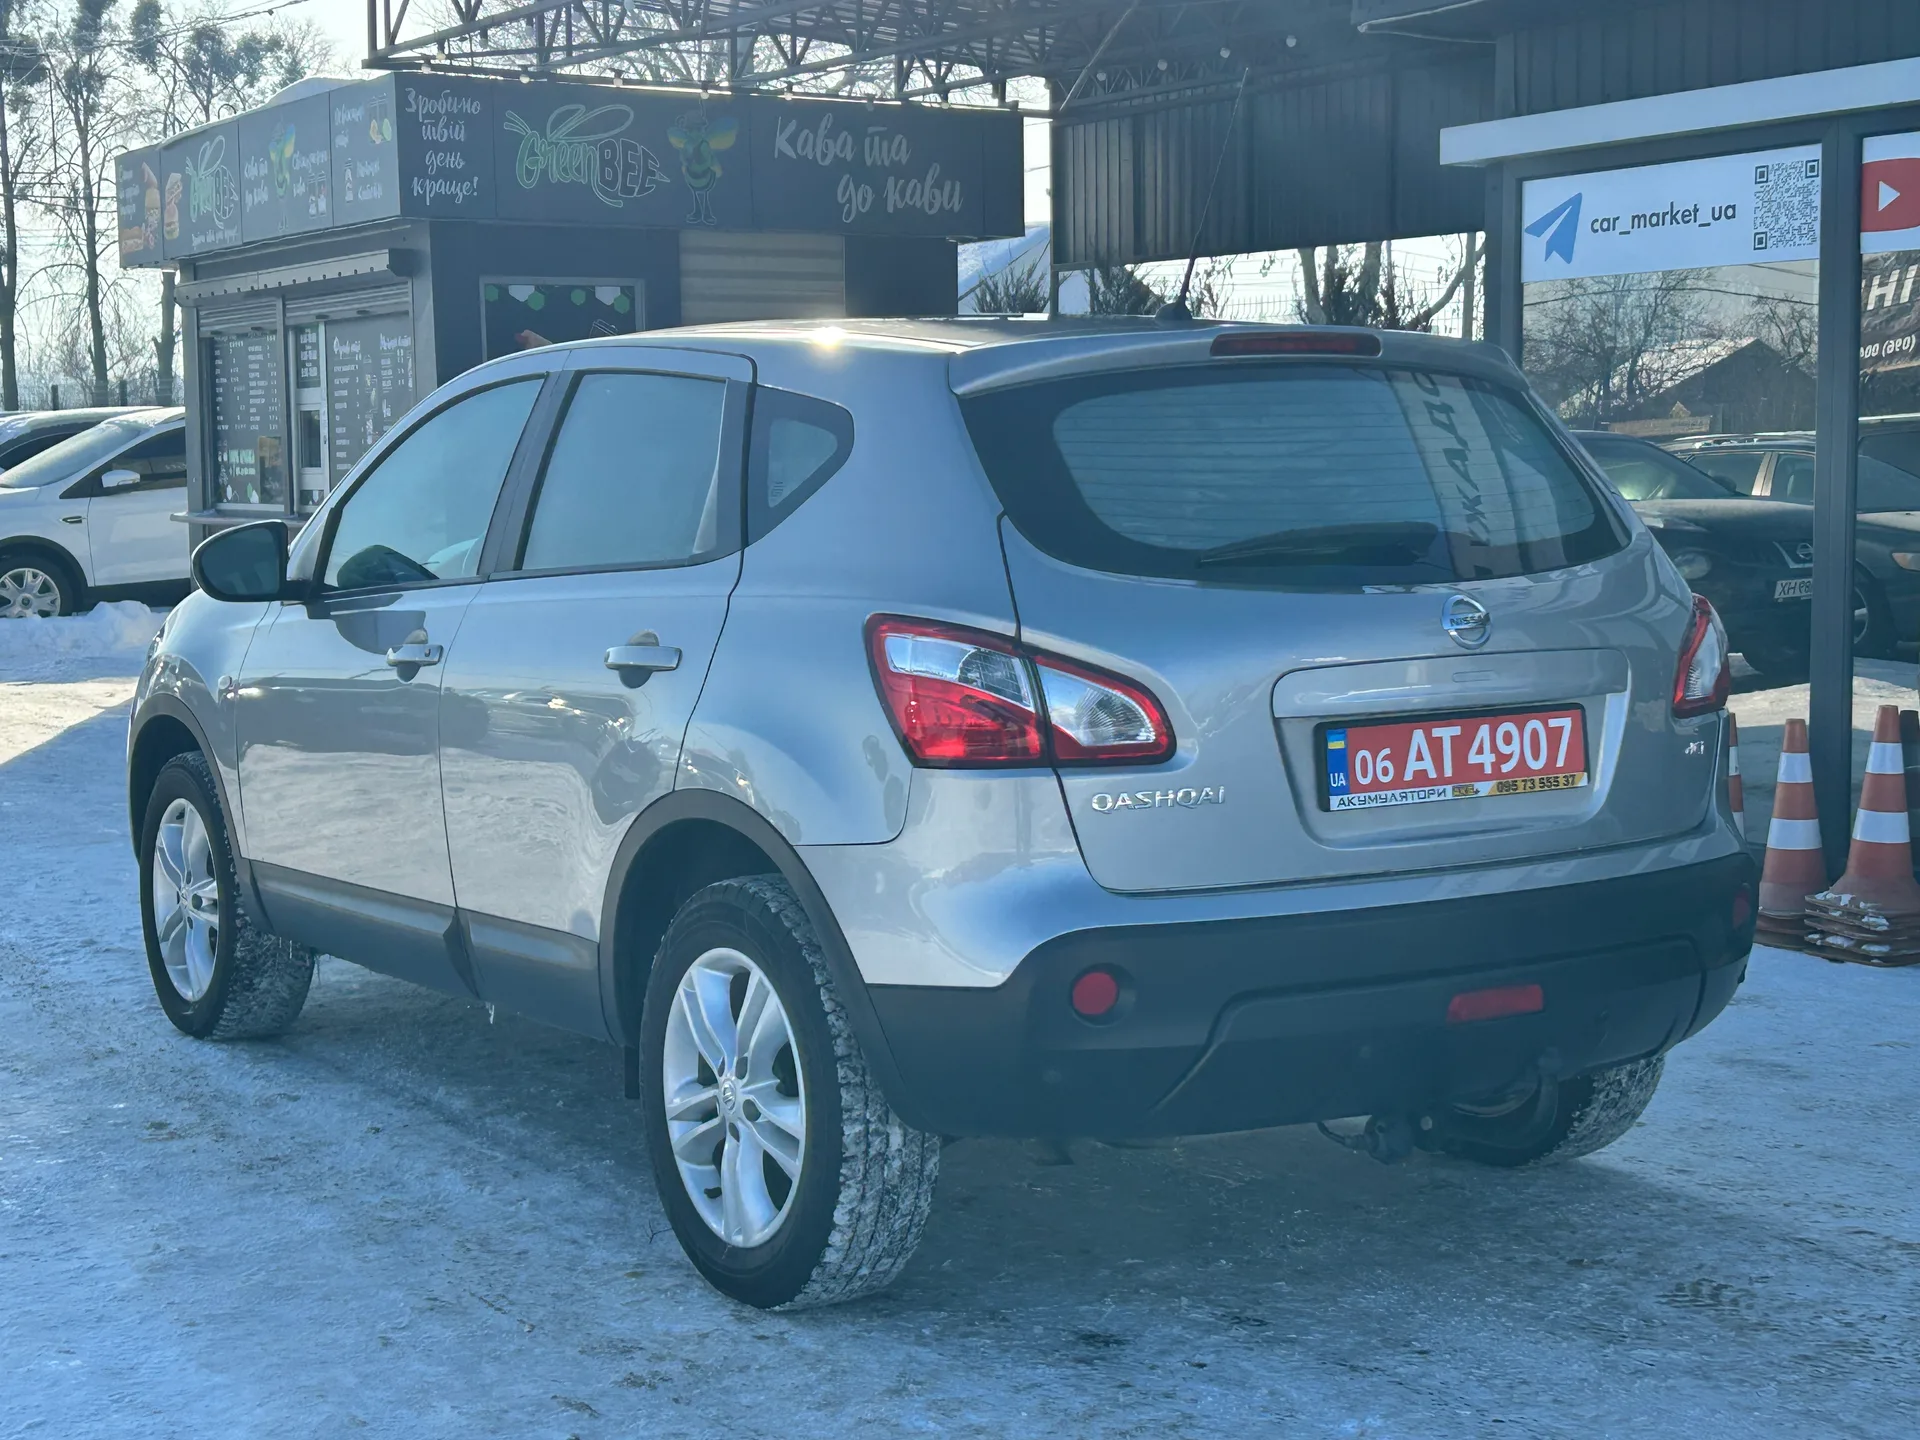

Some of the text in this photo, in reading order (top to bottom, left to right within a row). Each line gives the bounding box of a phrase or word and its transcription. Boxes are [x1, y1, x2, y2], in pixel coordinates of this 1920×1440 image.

[405, 88, 481, 121] Зробимо
[422, 114, 465, 143] твій
[774, 112, 912, 167] Кава та
[425, 149, 465, 175] день
[411, 176, 479, 205] краще!
[836, 163, 964, 223] до кави
[1590, 201, 1737, 235] car_market_ua
[1354, 717, 1572, 785] 06 AT 4907
[1330, 773, 1346, 788] UA
[1496, 779, 1518, 793] 095
[1521, 778, 1535, 791] 73
[1539, 776, 1560, 789] 555
[1562, 774, 1576, 787] 37
[1091, 786, 1225, 814] QASHQAI
[1337, 784, 1447, 808] АКУМУЛЯТОРИ
